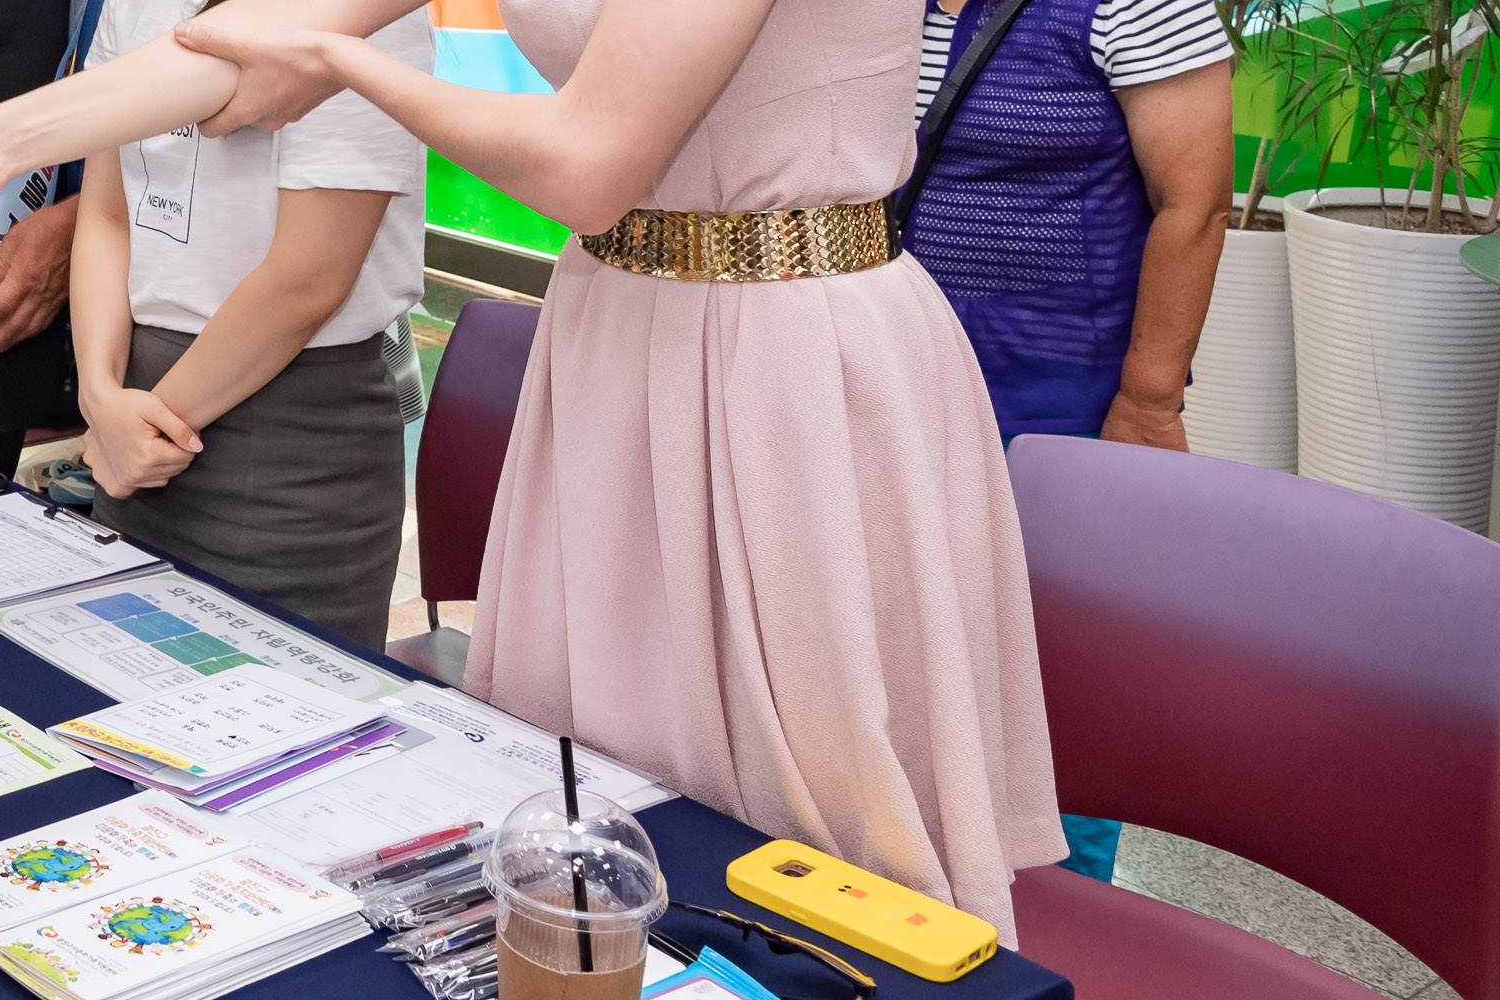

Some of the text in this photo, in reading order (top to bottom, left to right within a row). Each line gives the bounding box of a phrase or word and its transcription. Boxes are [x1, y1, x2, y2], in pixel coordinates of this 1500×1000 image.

[147, 194, 184, 217] NEW YORK
[166, 586, 250, 630] 외국인주민
